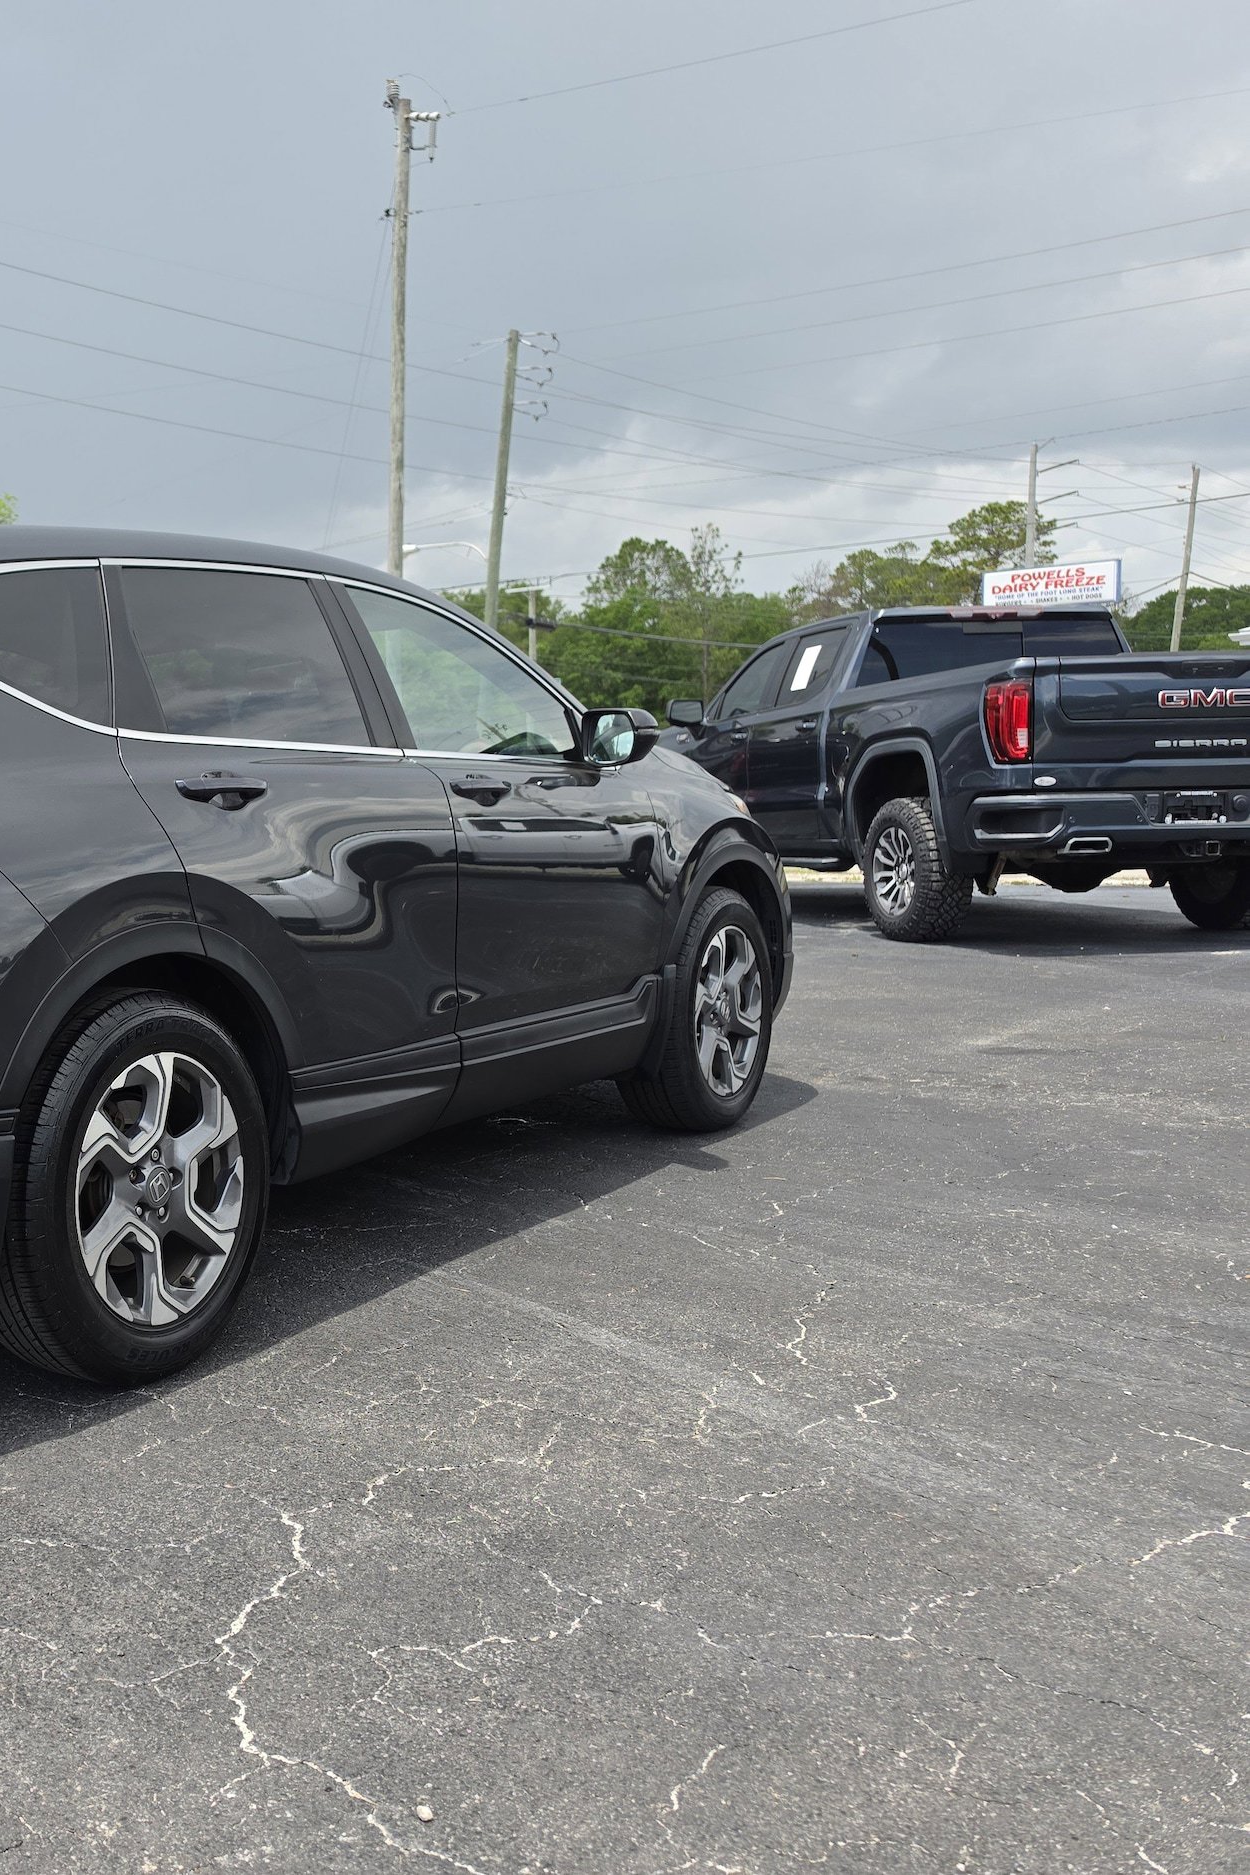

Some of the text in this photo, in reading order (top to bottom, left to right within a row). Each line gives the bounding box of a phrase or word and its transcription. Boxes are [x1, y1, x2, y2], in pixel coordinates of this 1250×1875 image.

[991, 575, 1106, 595] DAIRY FREEZE
[1011, 567, 1086, 584] POWELLS
[1158, 687, 1250, 708] GMC
[1154, 738, 1248, 748] SIERRA
[116, 1018, 164, 1051] TERRA
